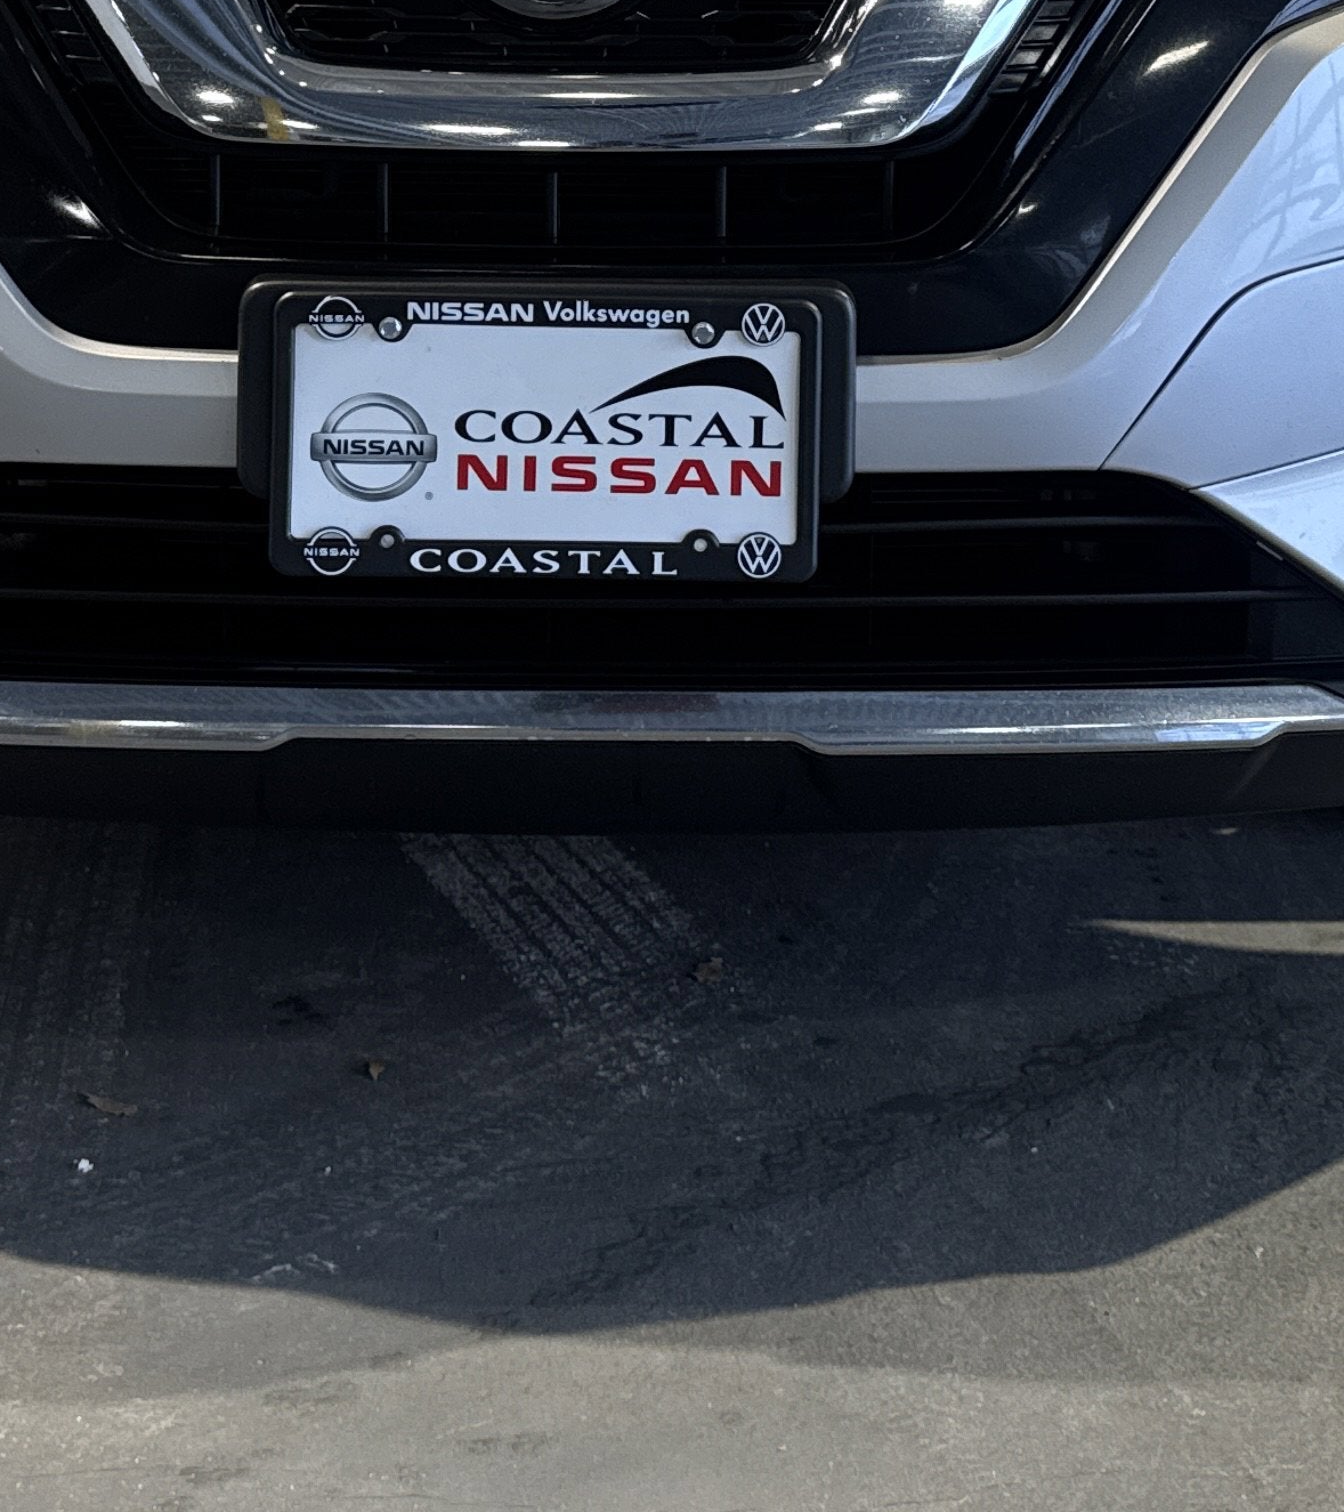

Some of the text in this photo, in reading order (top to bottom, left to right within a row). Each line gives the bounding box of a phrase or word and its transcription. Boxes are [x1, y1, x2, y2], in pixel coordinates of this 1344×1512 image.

[309, 314, 365, 323] NISSAN
[407, 300, 690, 328] NISSAN Volkswagen
[454, 408, 785, 449] COASTAL
[323, 439, 424, 456] NISSAN
[456, 453, 782, 497] NISSAN
[304, 547, 360, 557] NISSAN
[409, 547, 678, 576] COASTAL
